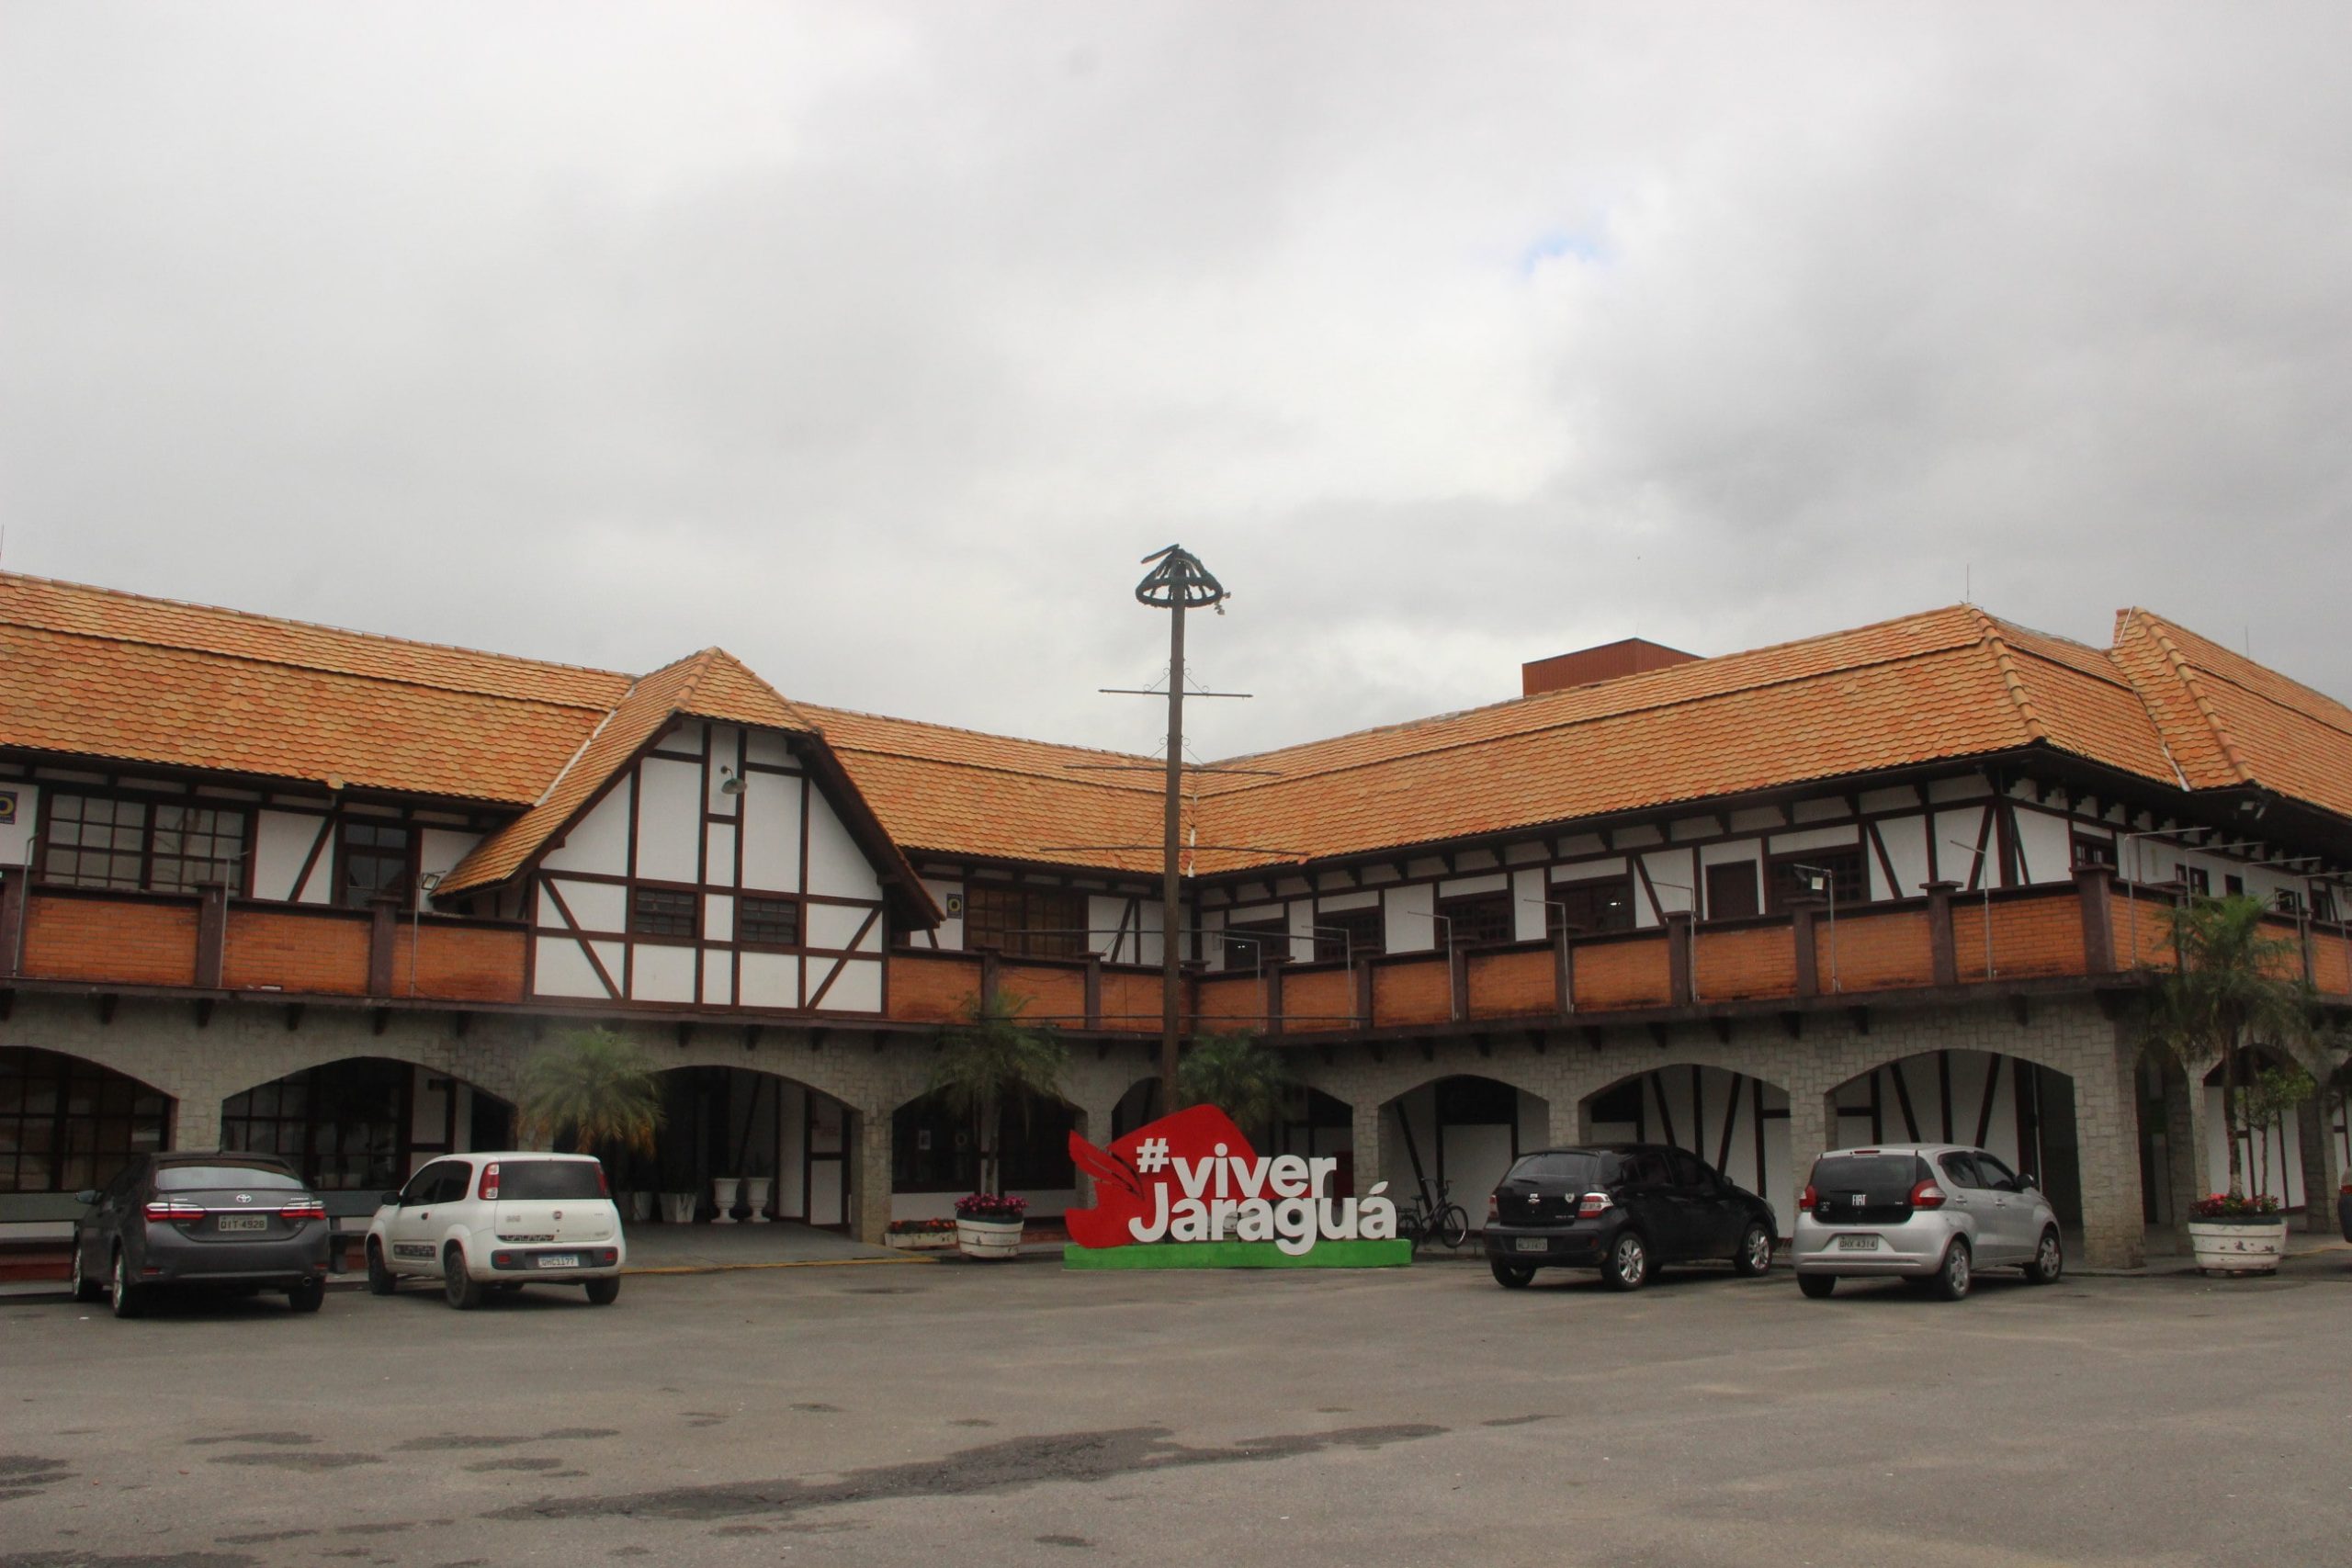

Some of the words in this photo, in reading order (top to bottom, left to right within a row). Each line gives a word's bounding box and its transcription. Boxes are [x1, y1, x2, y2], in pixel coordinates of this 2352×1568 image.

[1136, 1137, 1337, 1199] #viver
[1128, 1180, 1397, 1256] Jaraguá
[1852, 1194, 1867, 1206] FIAT
